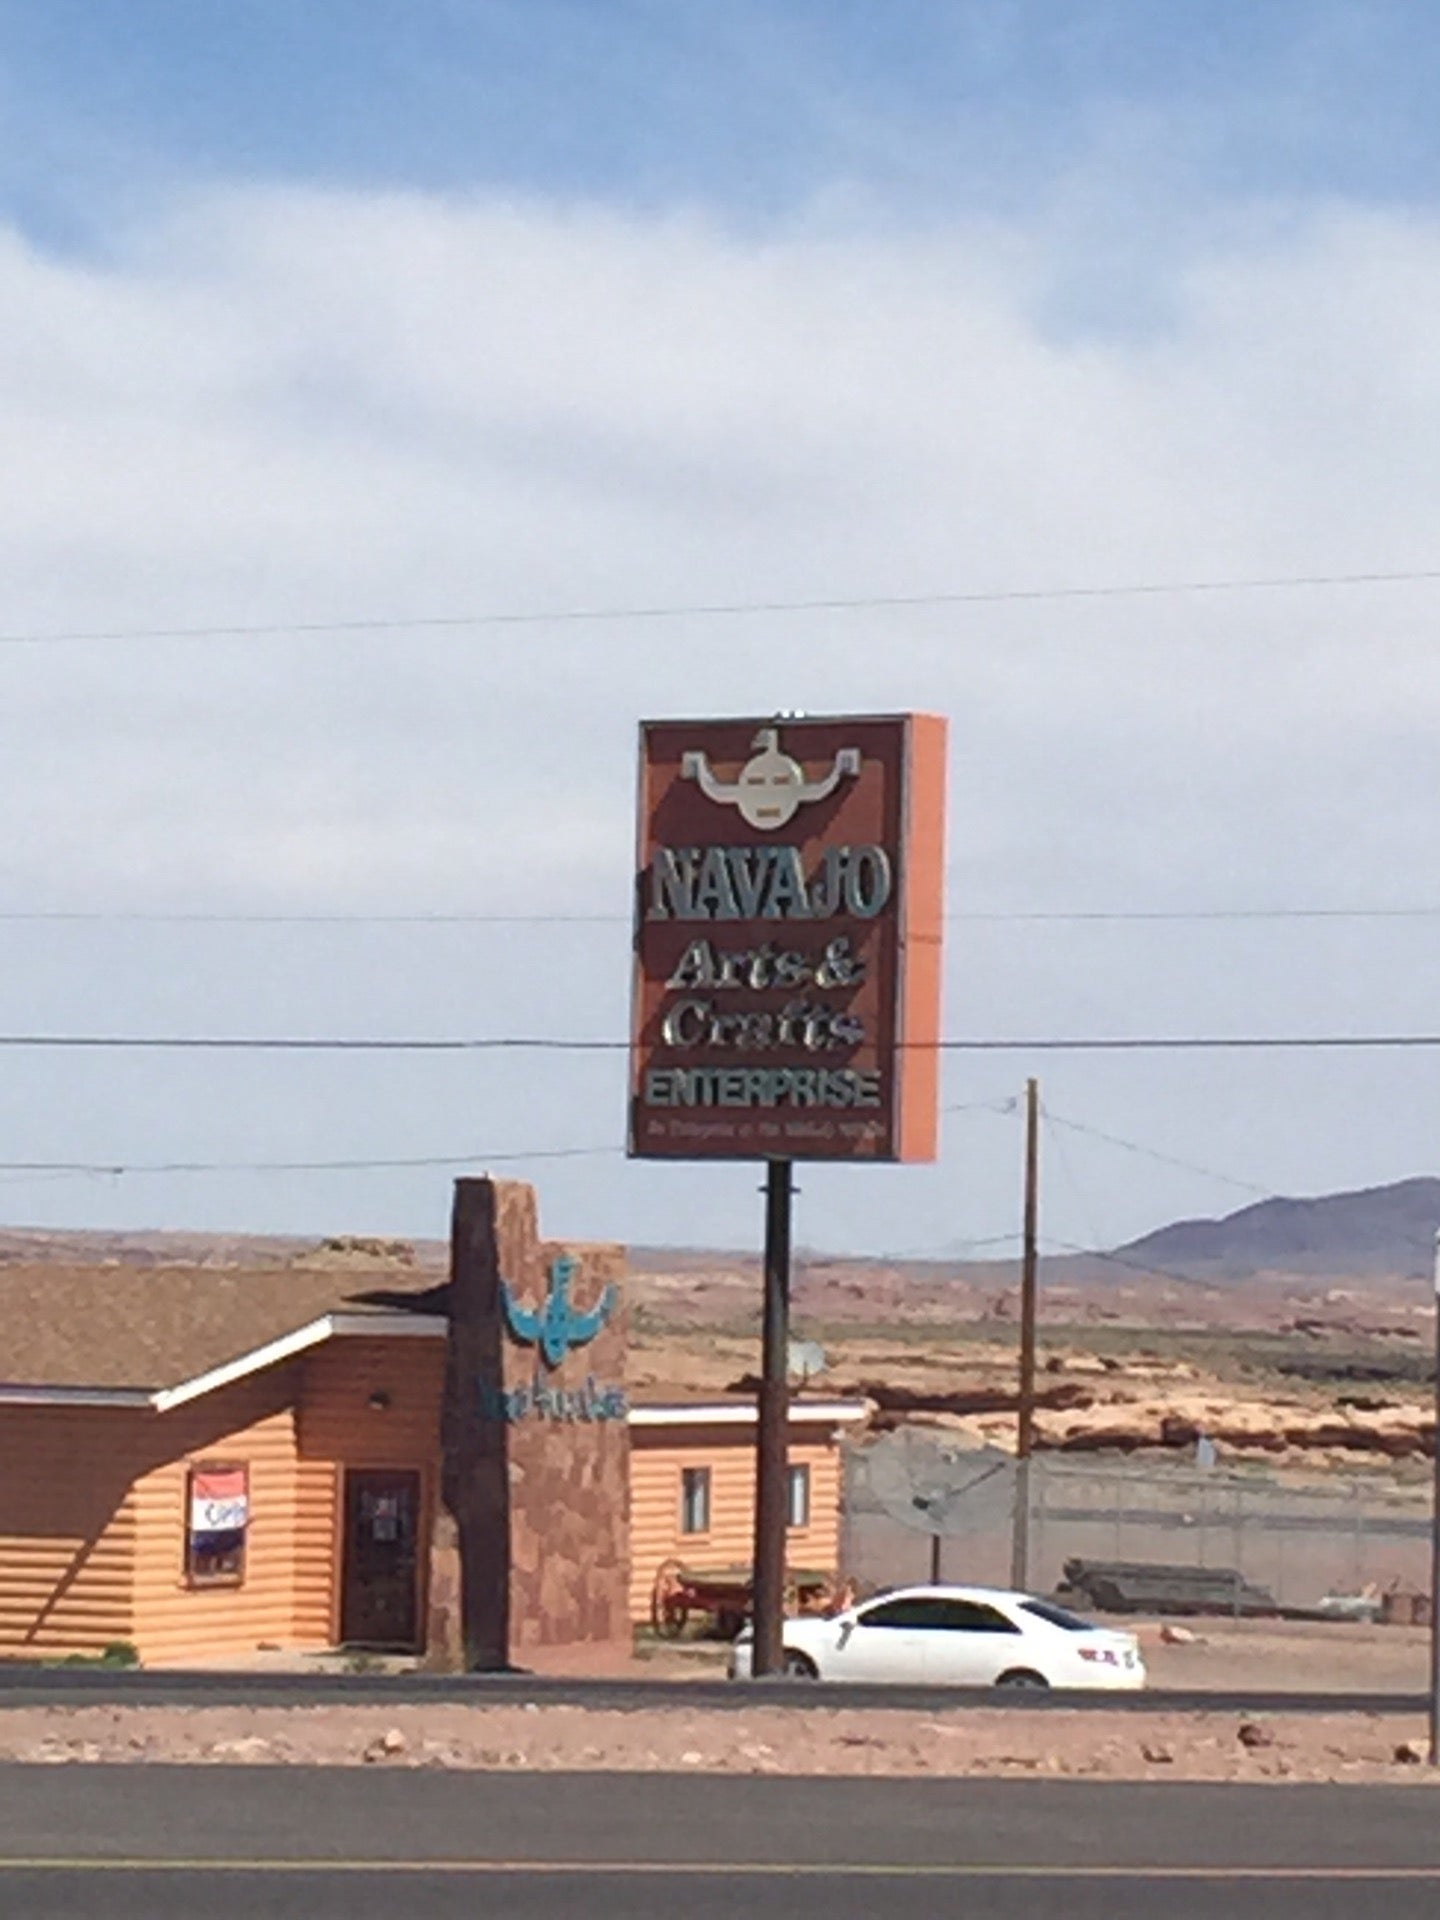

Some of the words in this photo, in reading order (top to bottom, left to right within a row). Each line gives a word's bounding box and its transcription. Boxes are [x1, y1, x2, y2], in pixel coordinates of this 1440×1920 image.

[647, 845, 890, 920] NAVAJO
[665, 939, 810, 990] Arts
[814, 937, 865, 987] &
[662, 1000, 864, 1050] Crafts
[646, 1068, 882, 1107] ENTERPRISE
